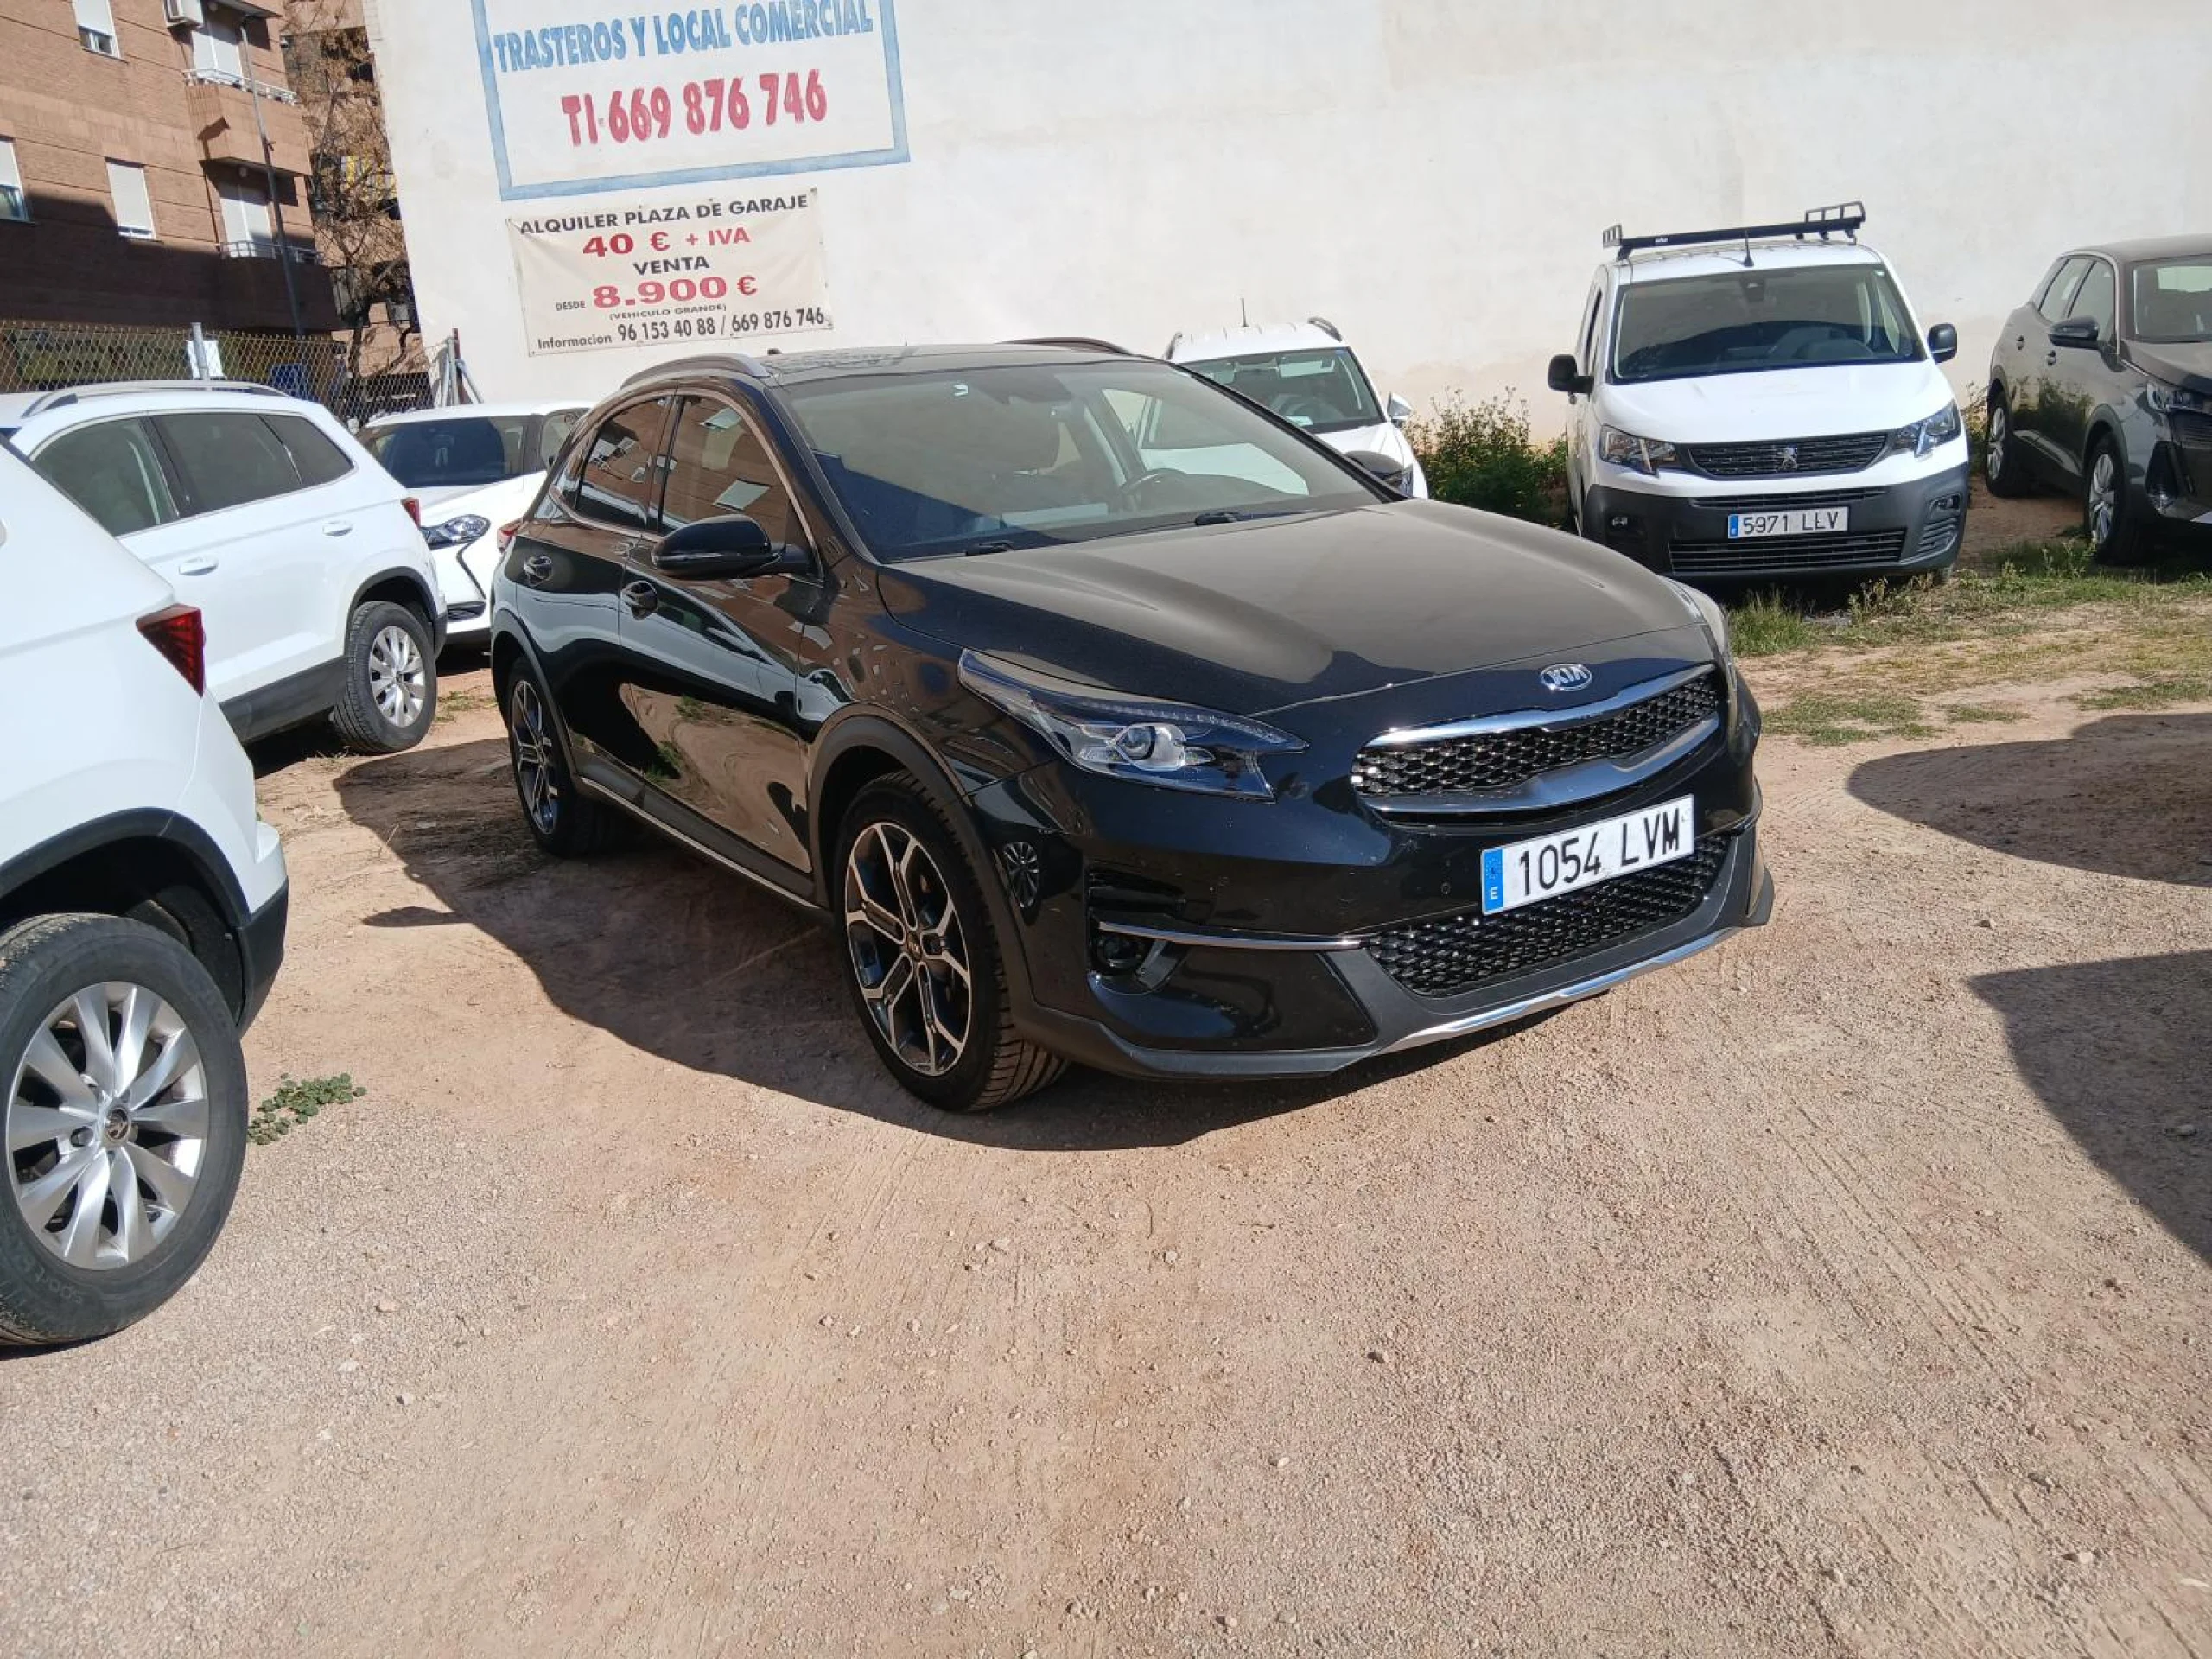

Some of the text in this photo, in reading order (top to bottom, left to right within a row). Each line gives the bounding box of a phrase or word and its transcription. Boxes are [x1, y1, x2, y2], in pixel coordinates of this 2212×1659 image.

[493, 0, 873, 73] TRASTEROS Y LOCAL COMERCIAL
[608, 86, 671, 143] 669
[683, 76, 750, 136] 876
[760, 68, 828, 126] 746
[519, 194, 808, 235] ALQUILER PLAZA DE GARAJE
[582, 226, 751, 257] 40 € + IVA
[632, 255, 710, 276] VENTA
[555, 275, 759, 312] DESDE 8.900 €
[610, 303, 727, 321] (VEHICULO GRANDE)
[537, 334, 613, 350] Informacion
[617, 323, 637, 341] 96
[642, 321, 669, 340] 153
[674, 319, 692, 337] 40
[696, 316, 716, 335] 88
[732, 313, 759, 333] 669
[764, 310, 791, 329] 876
[796, 307, 824, 327] 746
[1743, 511, 1839, 535] 5971 LLV
[1543, 664, 1590, 686] KIA
[1490, 807, 1680, 899] E 1054 LVM
